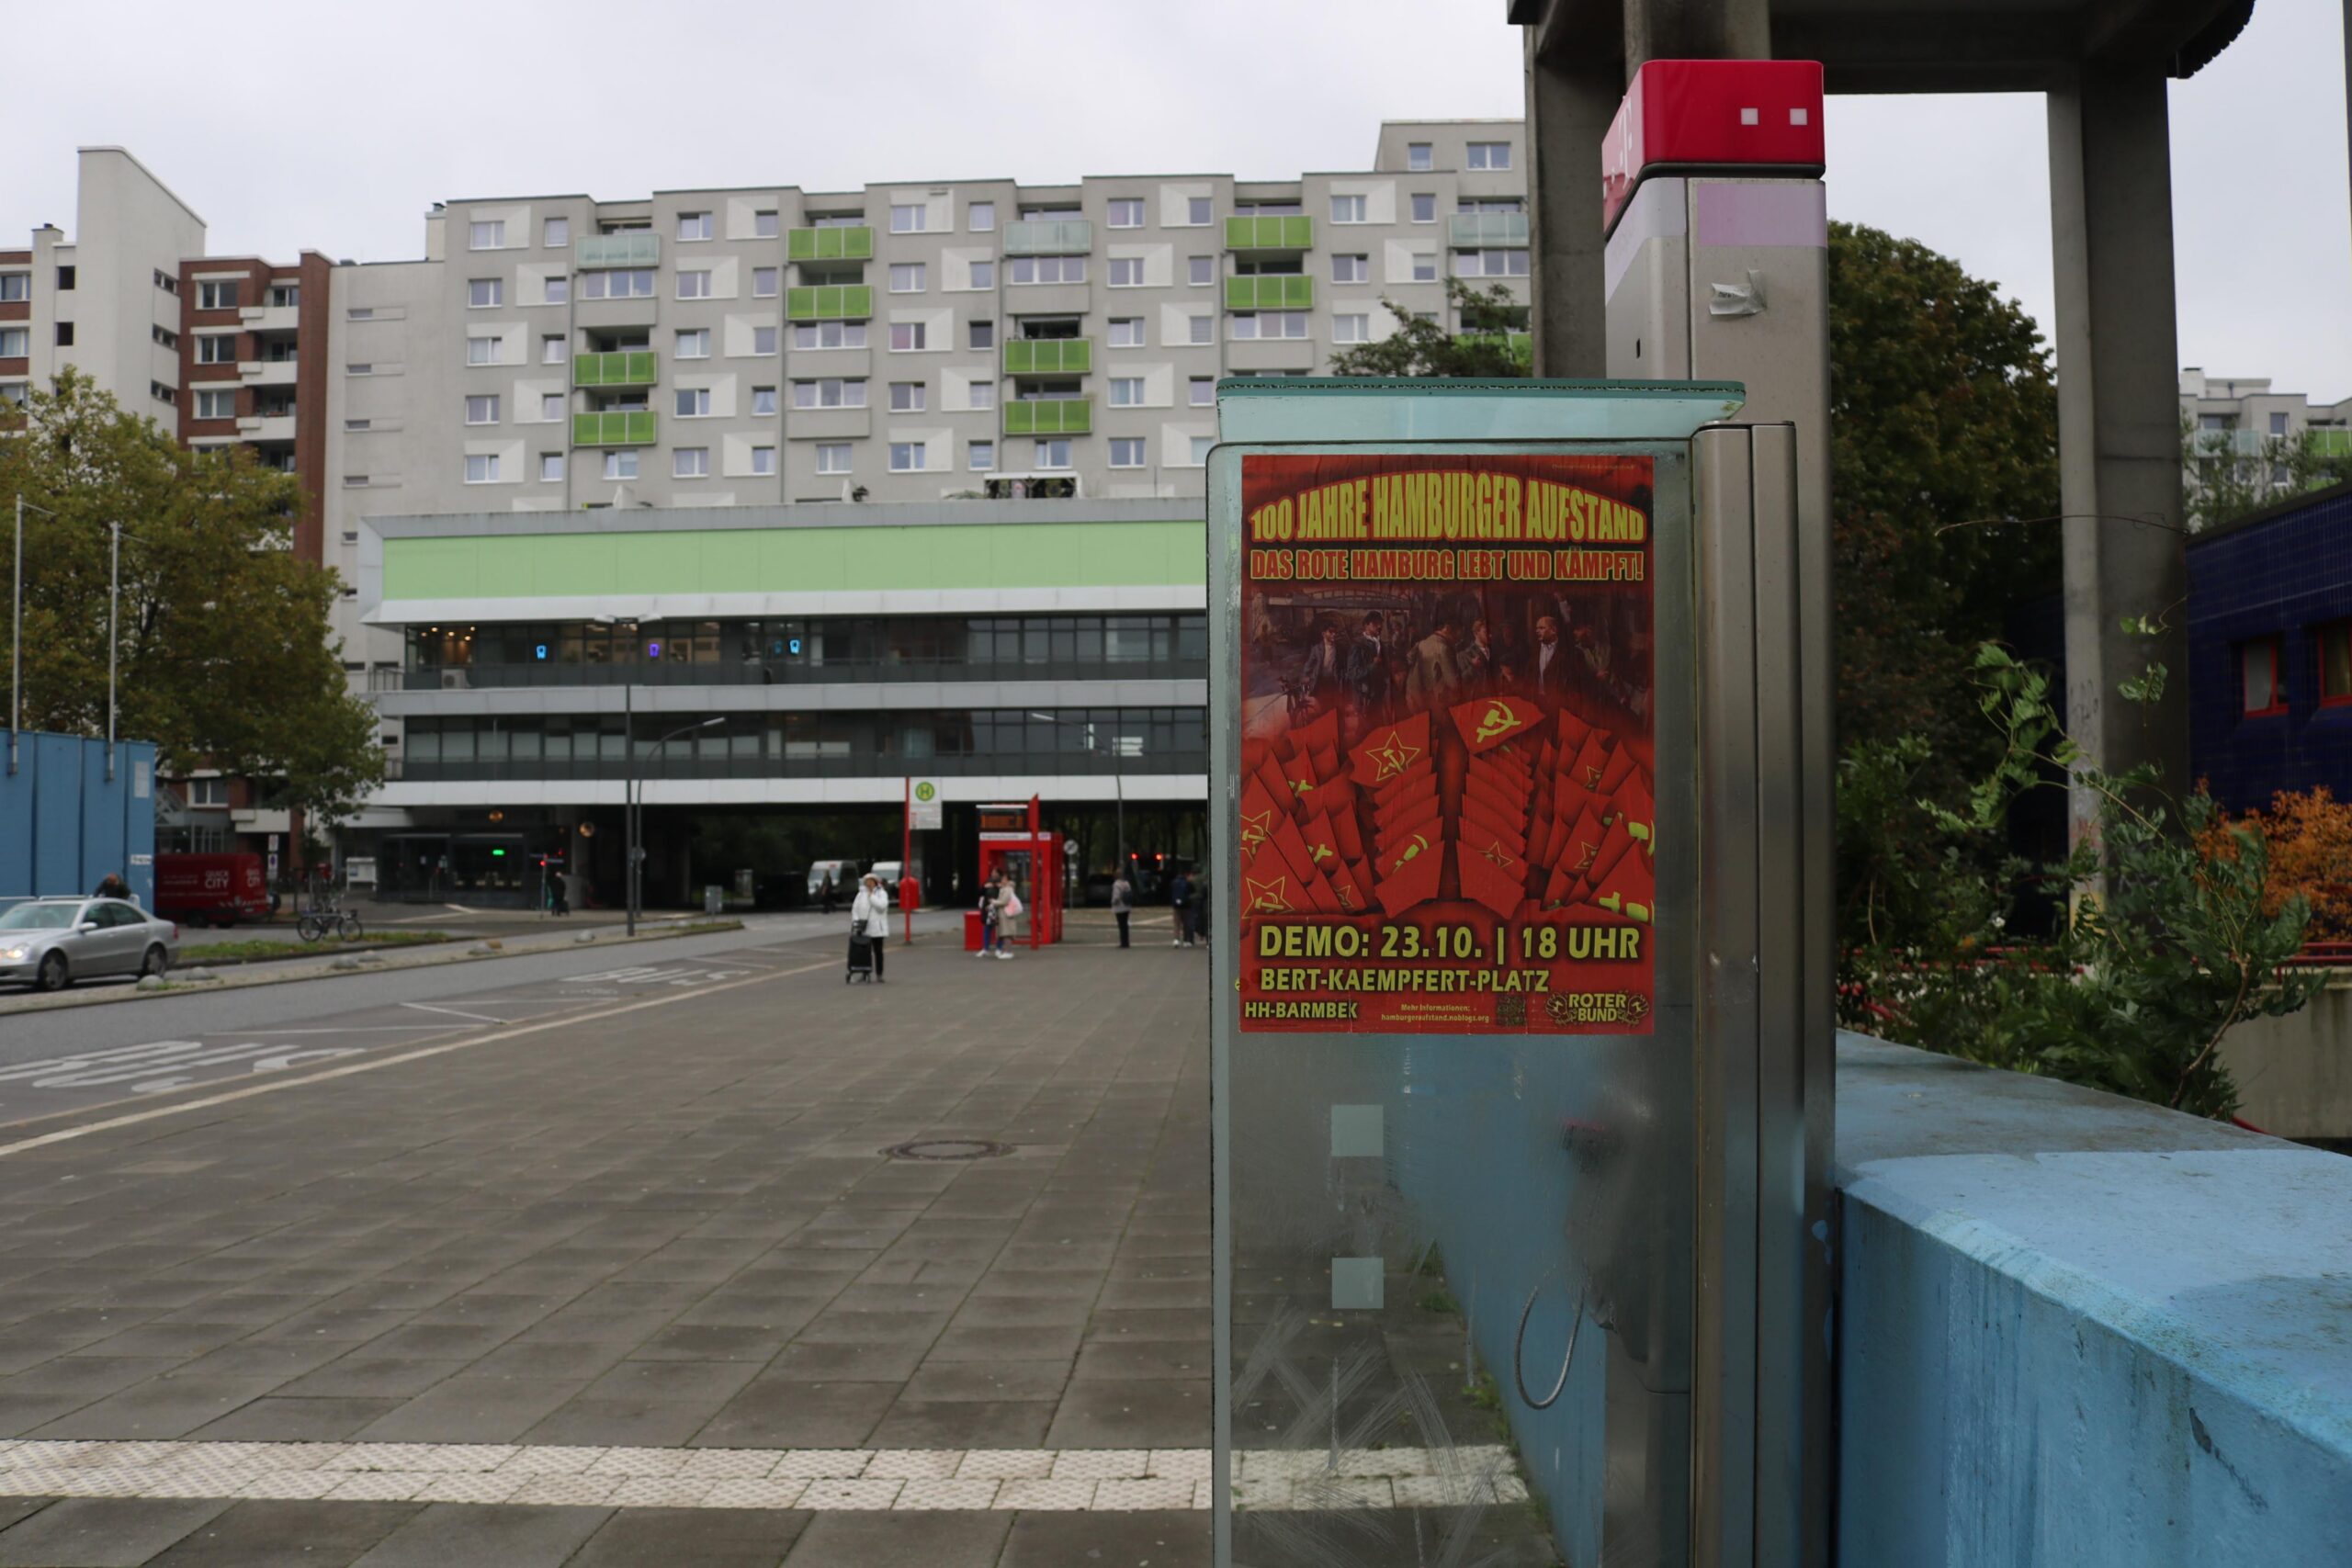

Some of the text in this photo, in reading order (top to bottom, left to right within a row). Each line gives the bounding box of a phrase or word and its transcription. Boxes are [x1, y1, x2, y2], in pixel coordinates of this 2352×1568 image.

[1250, 472, 1645, 541] 100 JAHRE HAMBURGER AUFSTAND
[1250, 546, 1645, 581] DAS ROTE HAMBURG LEBT UND KÄMPFT!
[205, 878, 230, 889] CITY
[1260, 925, 1369, 957] DEMO:
[1380, 926, 1483, 958] 23.10.
[1523, 927, 1557, 958] 18
[1568, 927, 1640, 959] UHR
[1261, 968, 1549, 992] BERT-KAEMPFERT-PLATZ
[1245, 1001, 1358, 1019] HH-BARMBEK
[1568, 993, 1627, 1008] ROTER
[1577, 1008, 1618, 1021] BUND
